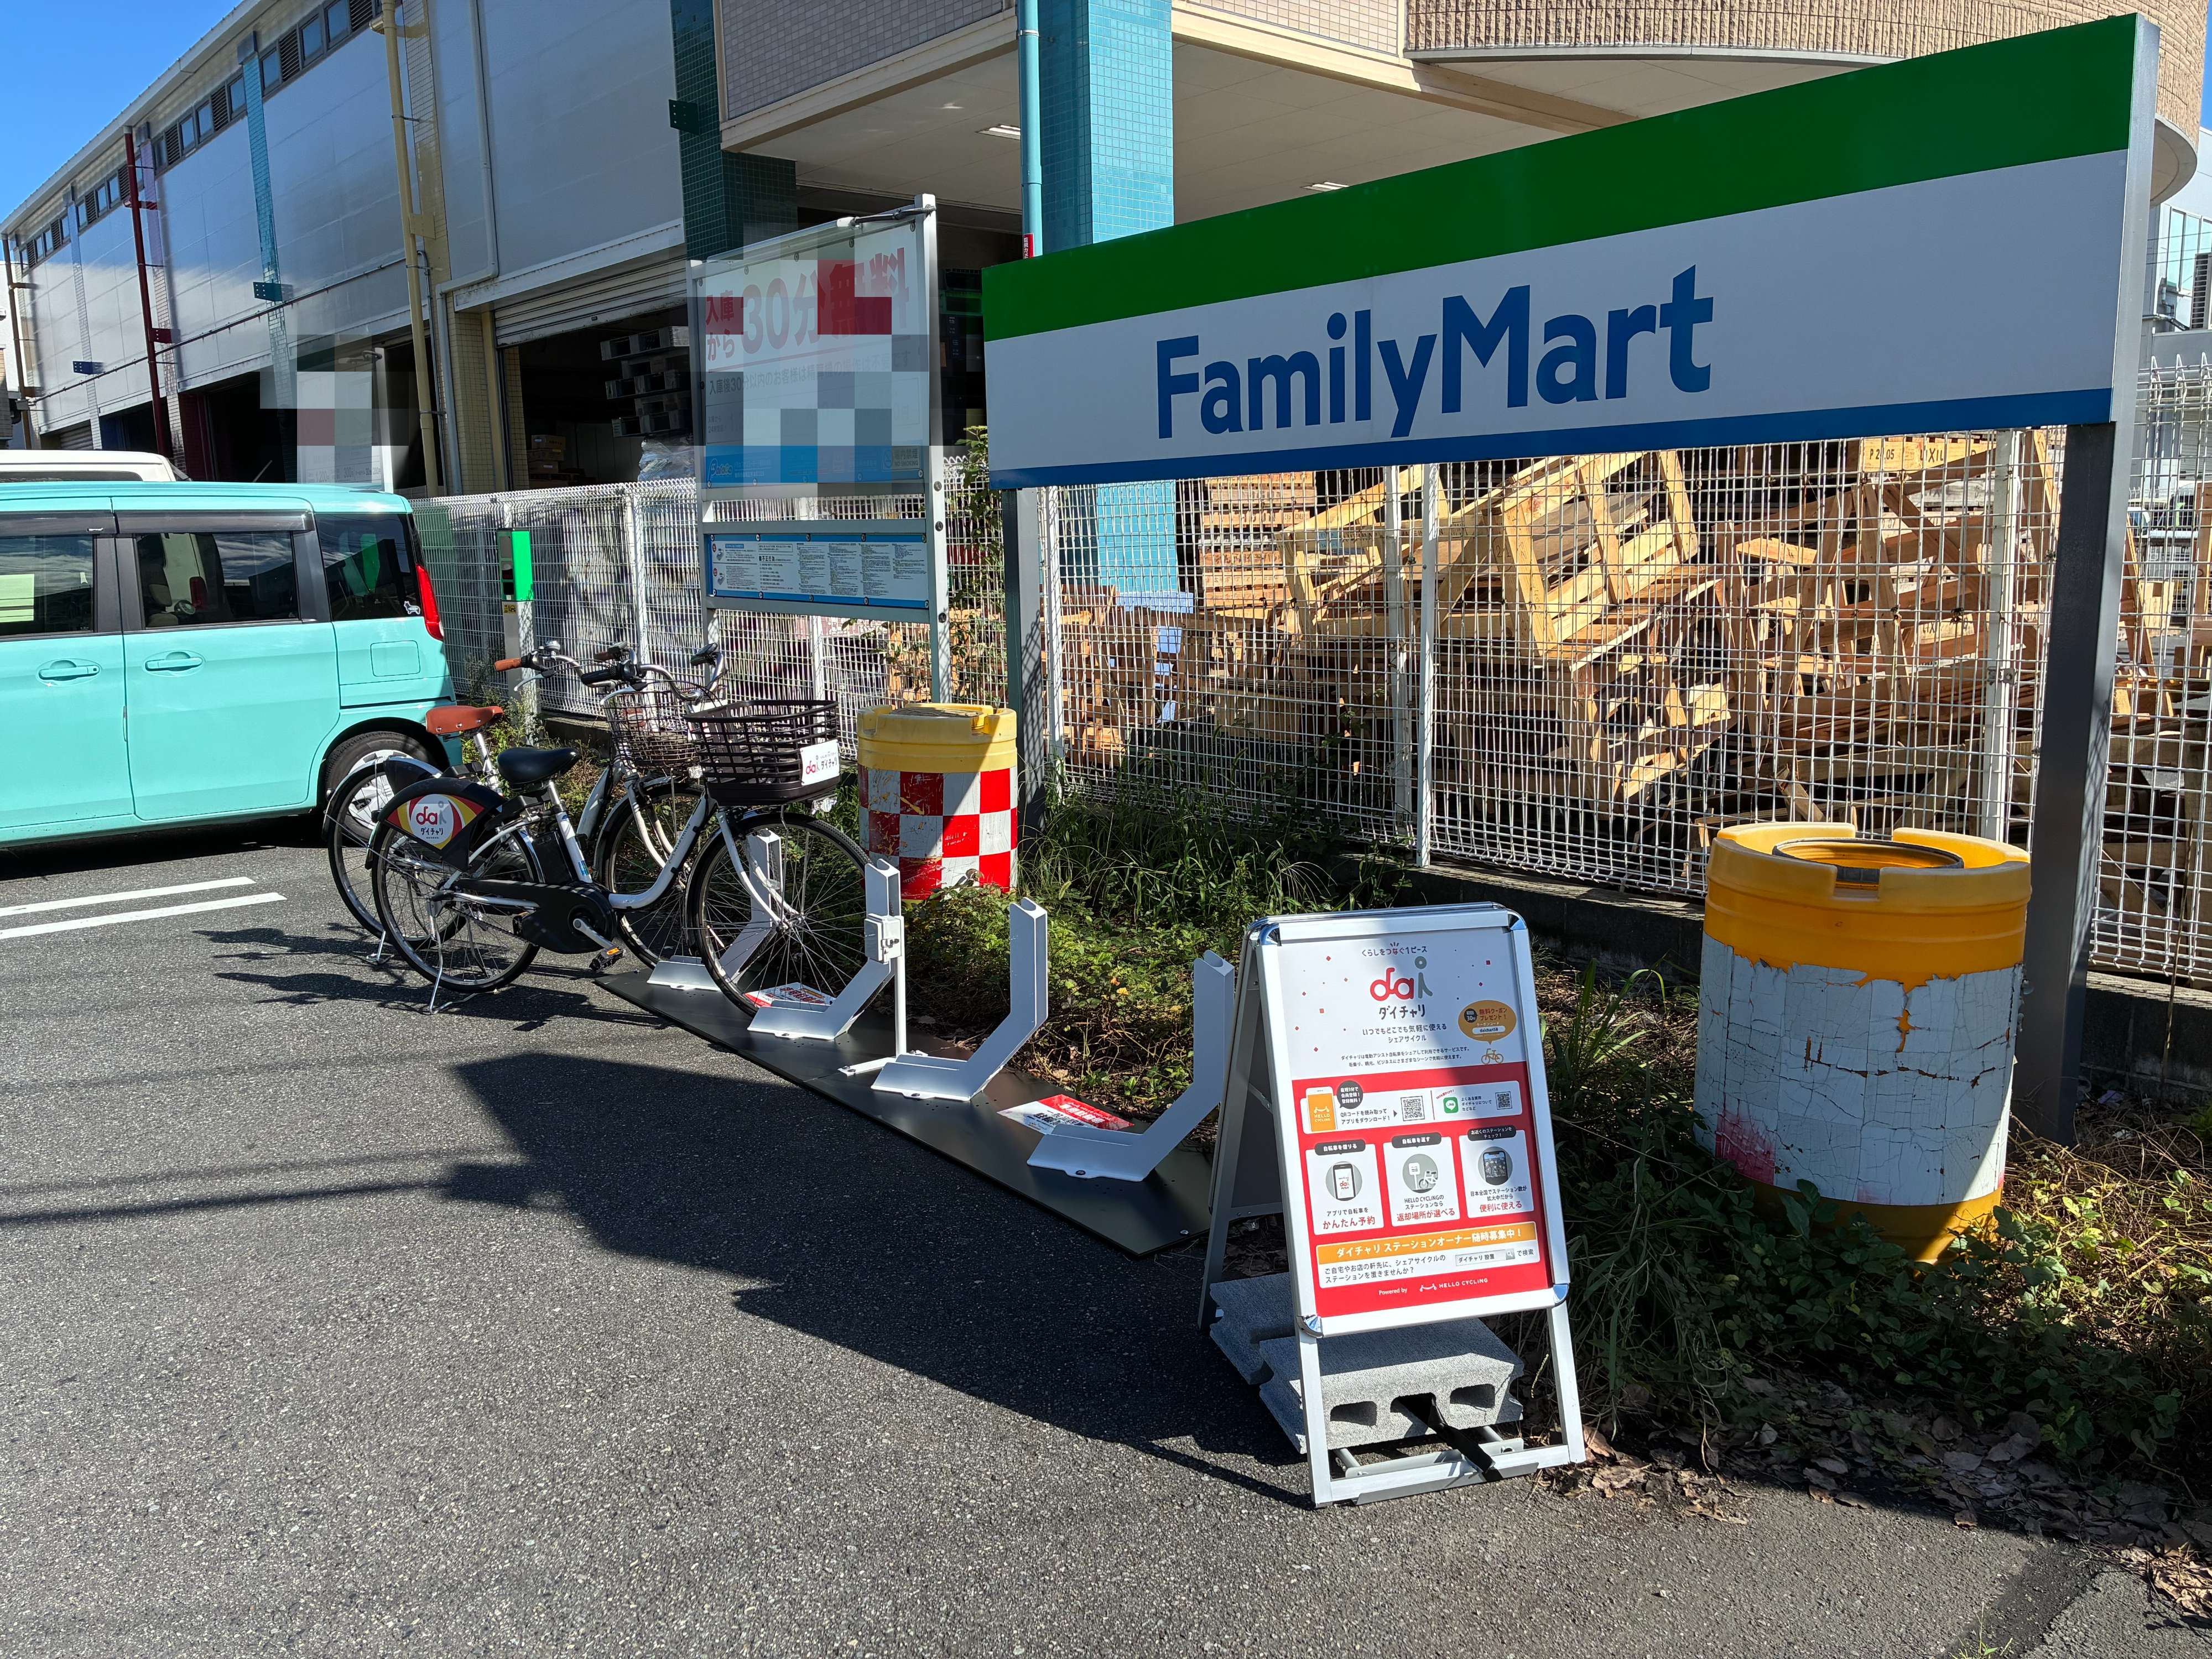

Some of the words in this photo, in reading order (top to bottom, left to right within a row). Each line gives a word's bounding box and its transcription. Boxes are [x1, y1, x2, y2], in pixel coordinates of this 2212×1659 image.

[1157, 264, 1713, 439] FamilyMart
[1875, 448, 1894, 460] 2.05
[420, 827, 444, 836] ダイチャリ
[1379, 1004, 1425, 1020] ダイチャリ
[1362, 1023, 1447, 1035] いつでもどこでも気軽に使える
[1388, 1035, 1427, 1044] シェアサイクル
[1341, 1109, 1387, 1117] QRコードを読み取って
[1324, 1143, 1357, 1152] 自転車を借りる
[1405, 1201, 1444, 1210] ステーションなら
[1480, 1201, 1522, 1212] 便利に使える
[1327, 1207, 1369, 1217] アプリで自転車を
[1397, 1208, 1455, 1222] 返却場所が選べる
[1323, 1215, 1376, 1230] かんたん予約
[1337, 1245, 1381, 1258] ダイチャリ
[1517, 1249, 1534, 1257] で検索
[1458, 1254, 1483, 1263] ダイチャリ
[1325, 1267, 1414, 1284] ステーションを置きませんか？
